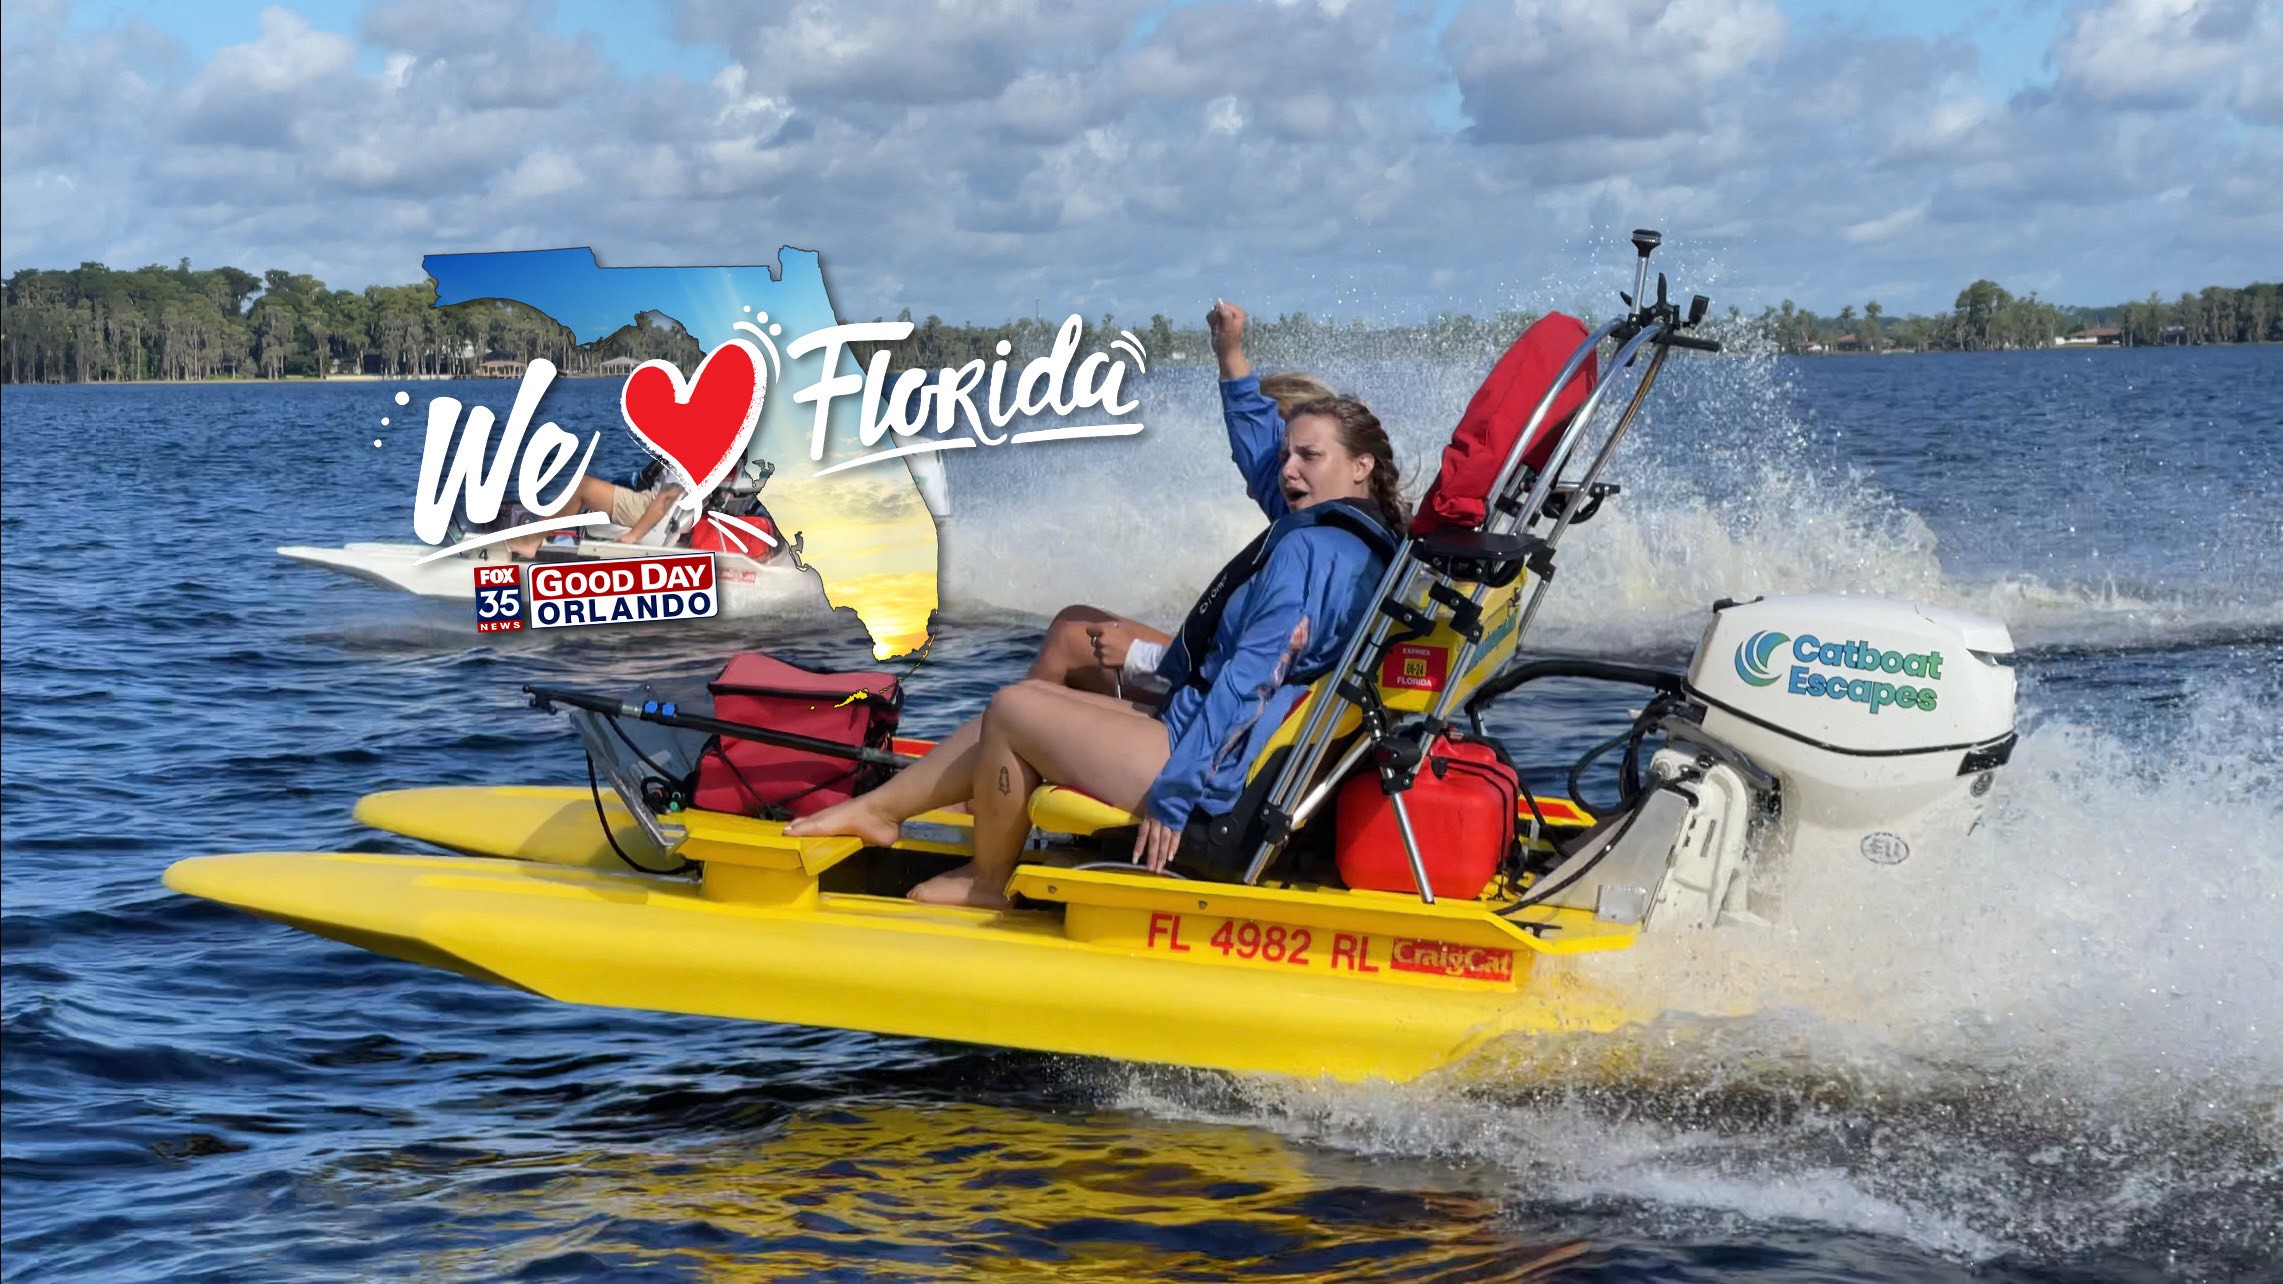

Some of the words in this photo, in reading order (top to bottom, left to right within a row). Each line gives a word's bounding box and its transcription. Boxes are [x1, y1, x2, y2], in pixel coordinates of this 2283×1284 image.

[1792, 634, 1944, 680] Catboat
[1397, 677, 1433, 687] FLORIDA
[1788, 665, 1938, 714] Escapes
[1147, 912, 1190, 952] FL
[1210, 920, 1312, 965] 4982
[1331, 932, 1379, 973] RL
[1393, 940, 1512, 977] CraigCat
